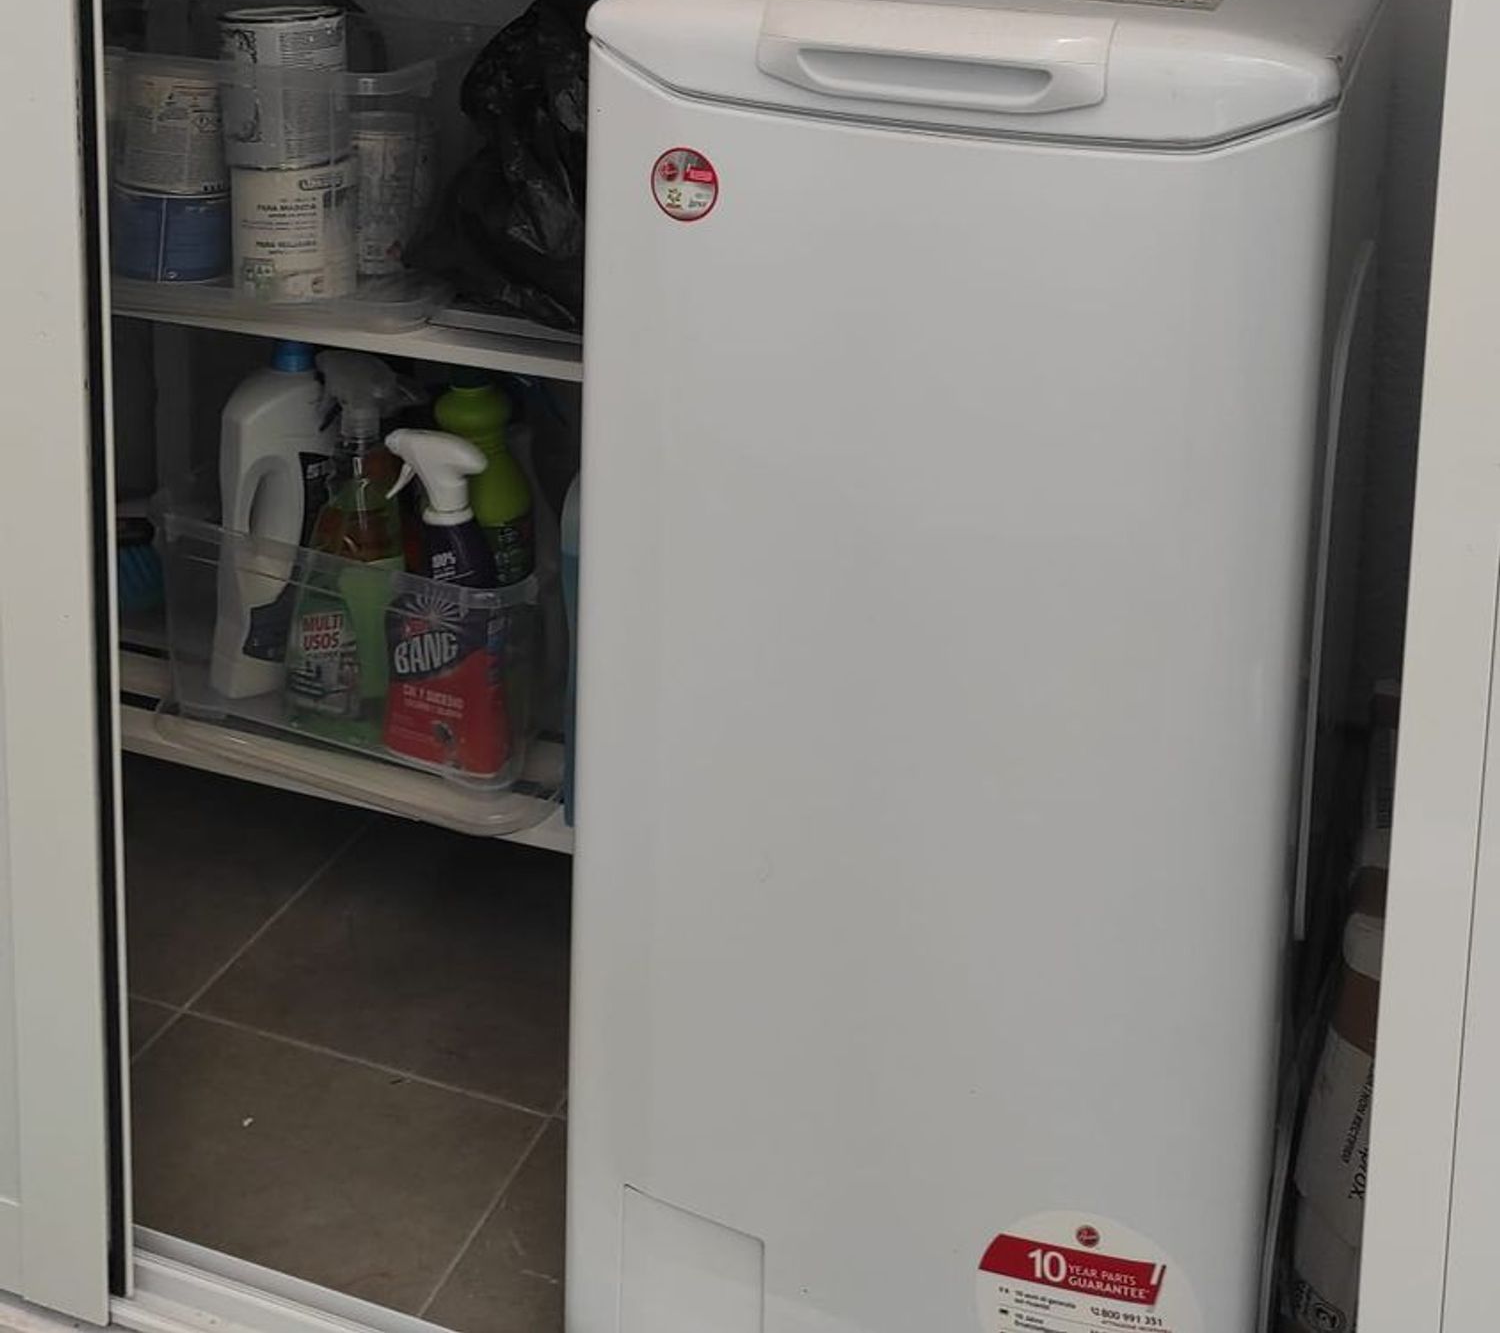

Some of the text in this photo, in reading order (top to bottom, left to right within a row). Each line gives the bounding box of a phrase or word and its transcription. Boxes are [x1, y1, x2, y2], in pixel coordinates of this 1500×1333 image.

[303, 615, 343, 632] MULTI
[303, 633, 340, 651] USOS
[394, 633, 459, 674] BANG
[1028, 1248, 1067, 1282] 10
[1068, 1264, 1137, 1287] YEAR PARTS
[1102, 1310, 1120, 1320] 800
[1123, 1313, 1141, 1323] 991
[1145, 1316, 1163, 1327] 351
